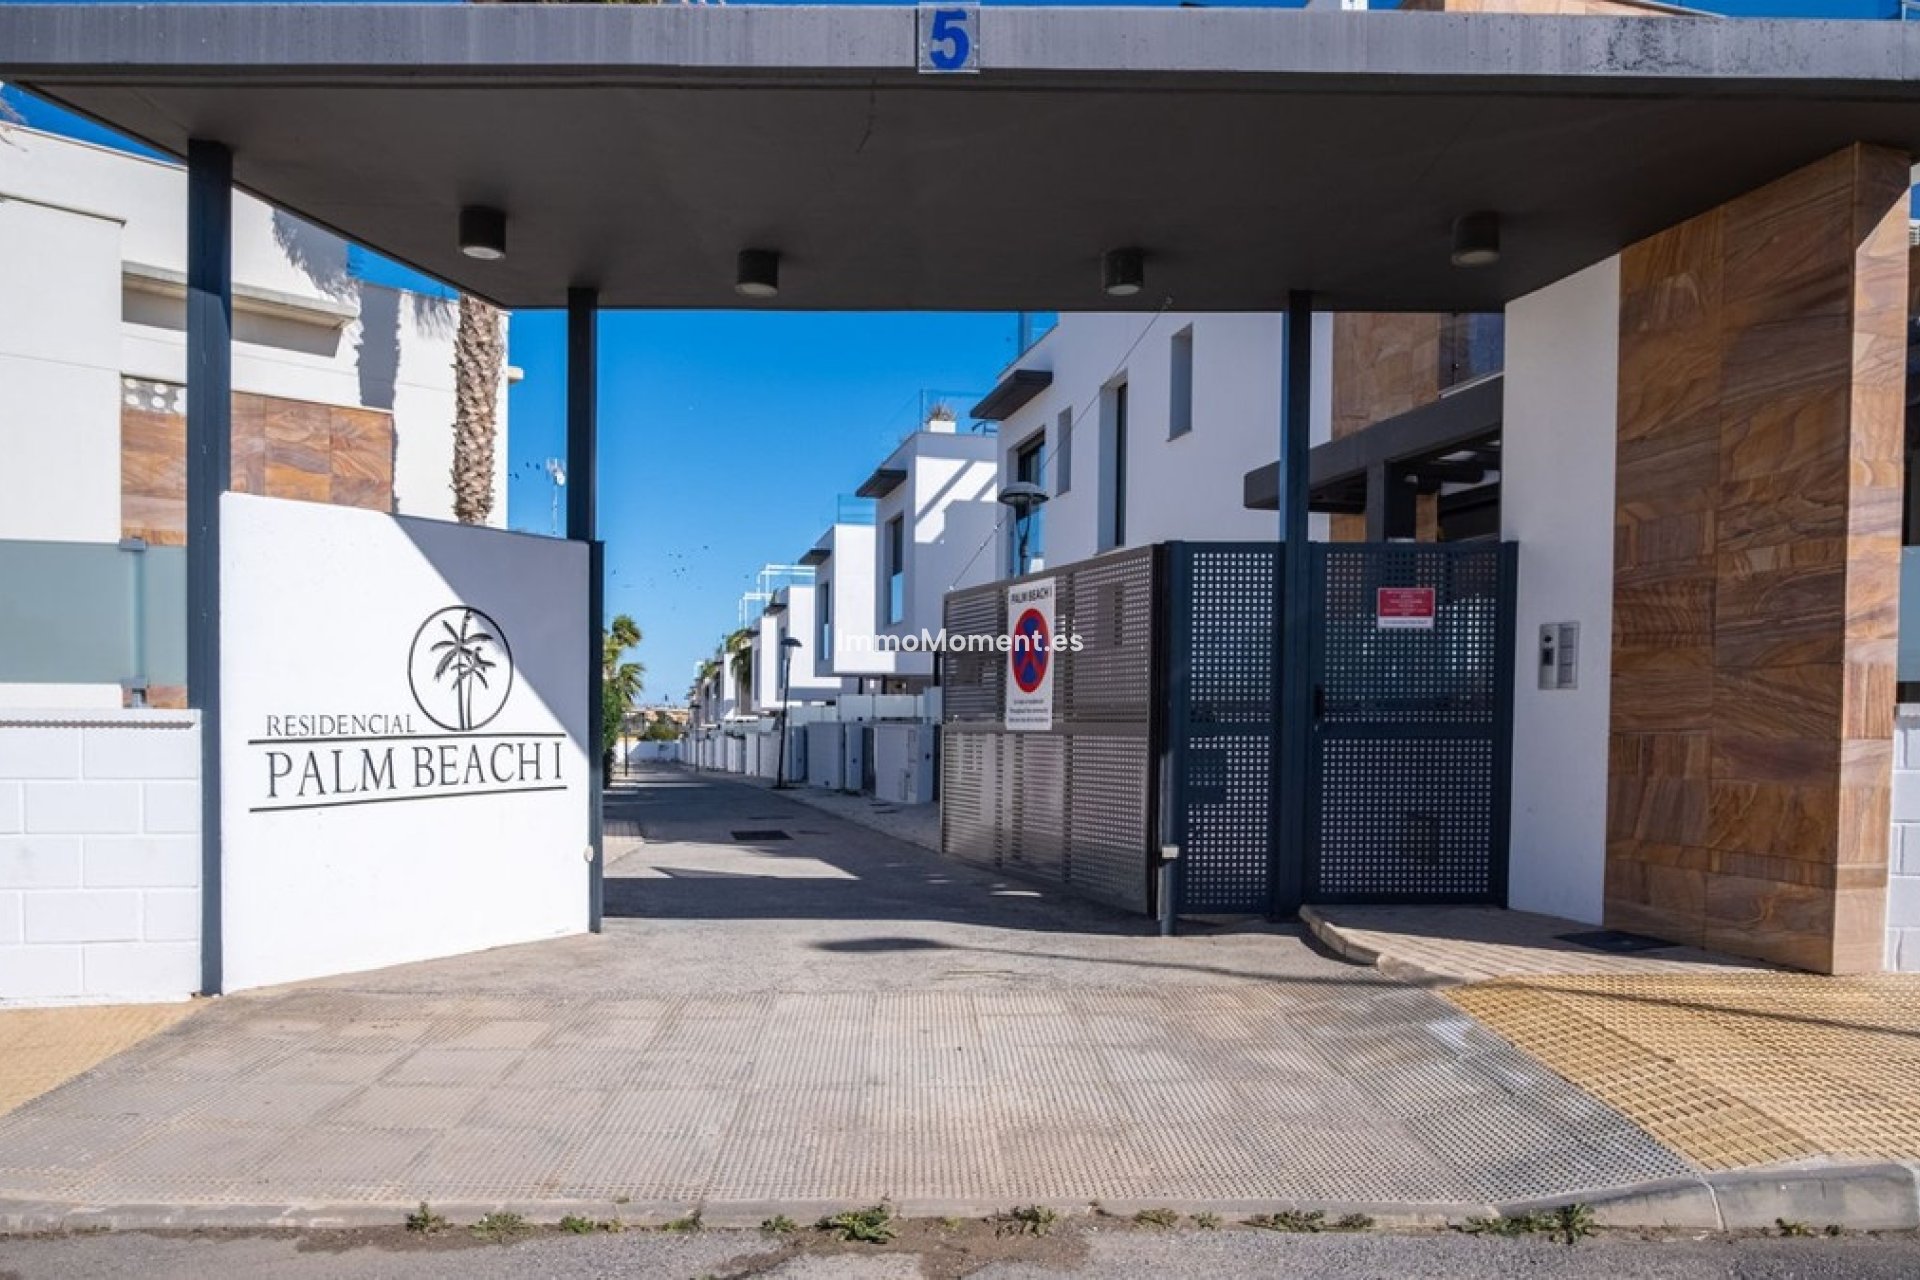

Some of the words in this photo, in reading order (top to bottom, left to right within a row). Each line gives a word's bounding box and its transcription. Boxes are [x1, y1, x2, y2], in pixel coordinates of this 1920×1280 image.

[930, 9, 970, 70] 5
[1029, 587, 1048, 601] BEACH
[266, 714, 417, 737] RESIDENCIAL
[265, 748, 397, 798] PALM
[413, 743, 542, 788] BEACH
[553, 742, 562, 780] I
